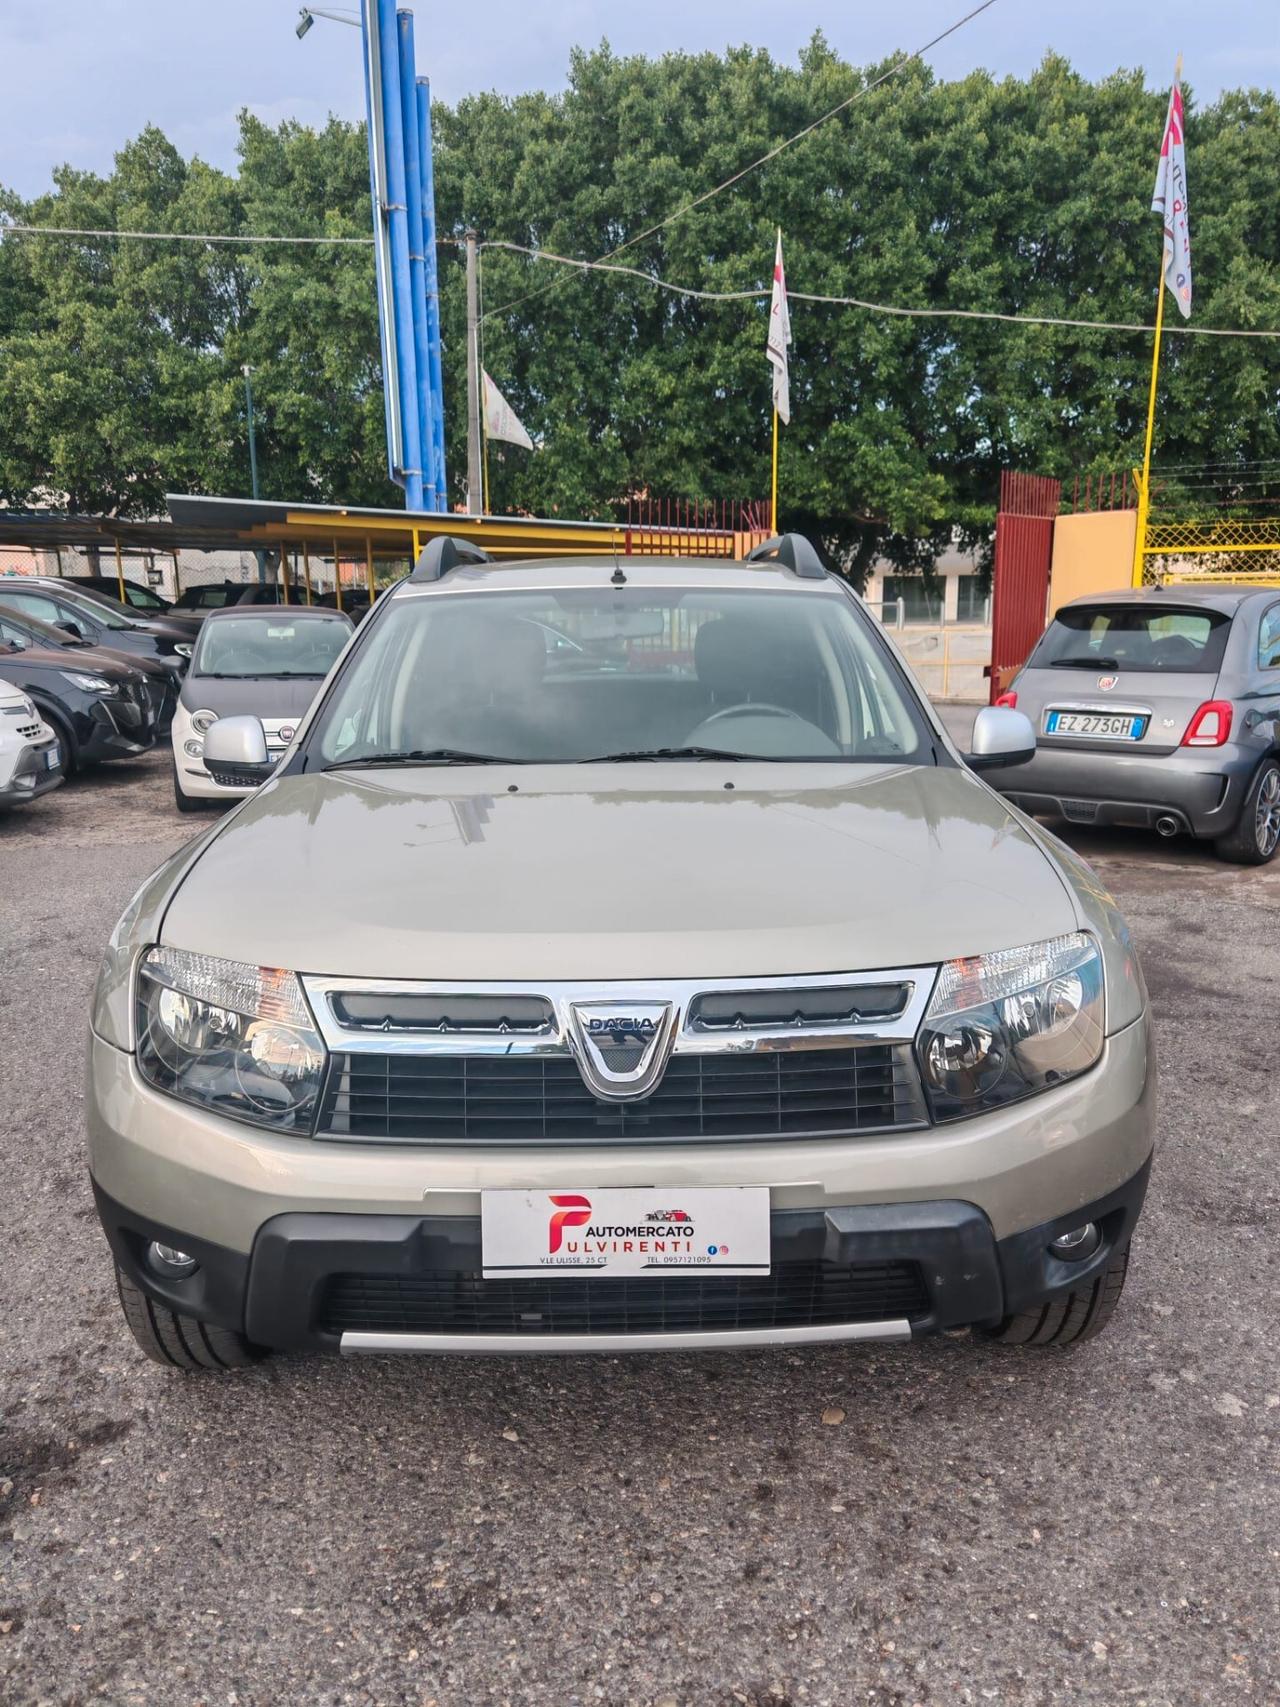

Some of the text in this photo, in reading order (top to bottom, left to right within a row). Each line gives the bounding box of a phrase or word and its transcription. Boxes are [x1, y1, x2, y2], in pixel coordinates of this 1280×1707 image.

[1057, 715, 1131, 734] EZ 273GH
[589, 1018, 655, 1030] DACIA
[585, 1226, 694, 1238] AUTOMERCATO
